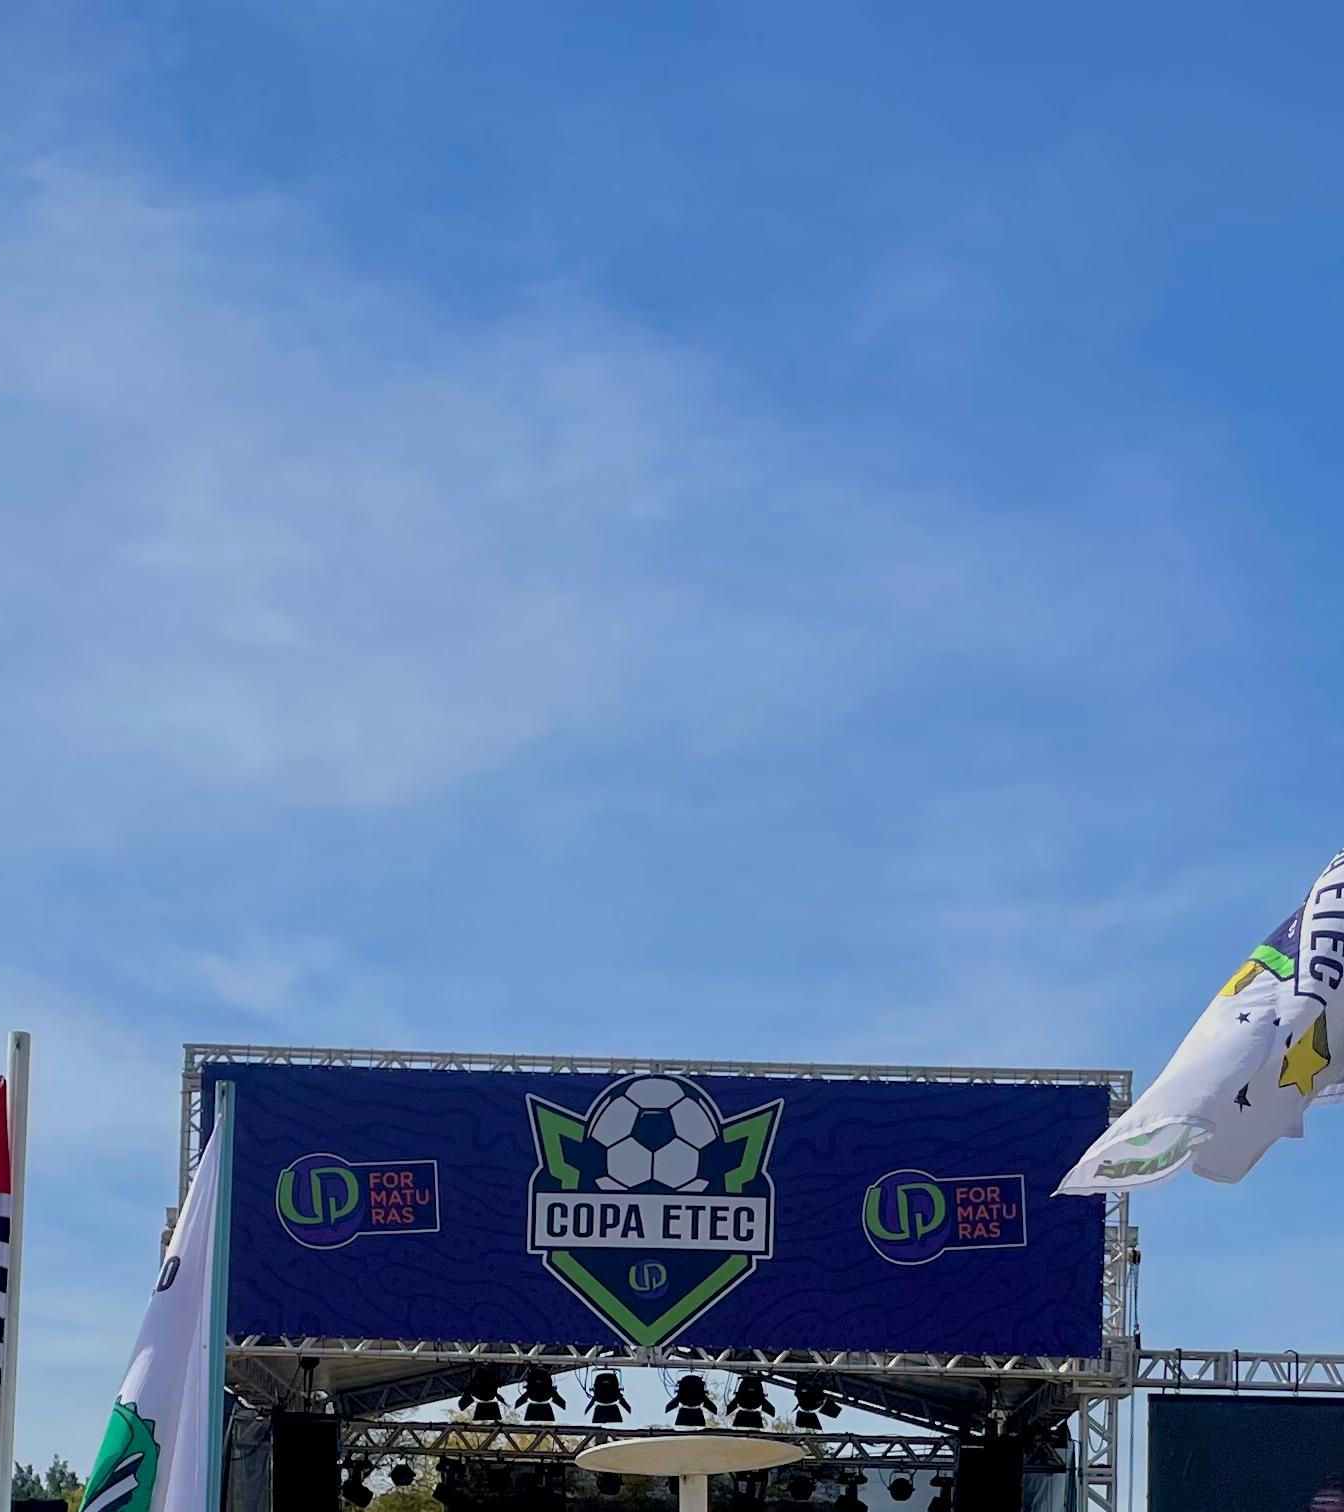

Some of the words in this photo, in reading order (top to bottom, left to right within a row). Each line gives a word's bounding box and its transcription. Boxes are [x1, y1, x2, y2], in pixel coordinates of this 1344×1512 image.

[368, 1172, 414, 1190] FOR
[368, 1188, 431, 1208] MATU
[956, 1186, 1001, 1205] FOR
[370, 1207, 416, 1226] RAS
[545, 1201, 646, 1240] COPA
[661, 1204, 756, 1243] ETEC
[956, 1202, 1017, 1223] MATU
[958, 1222, 1001, 1240] RAS
